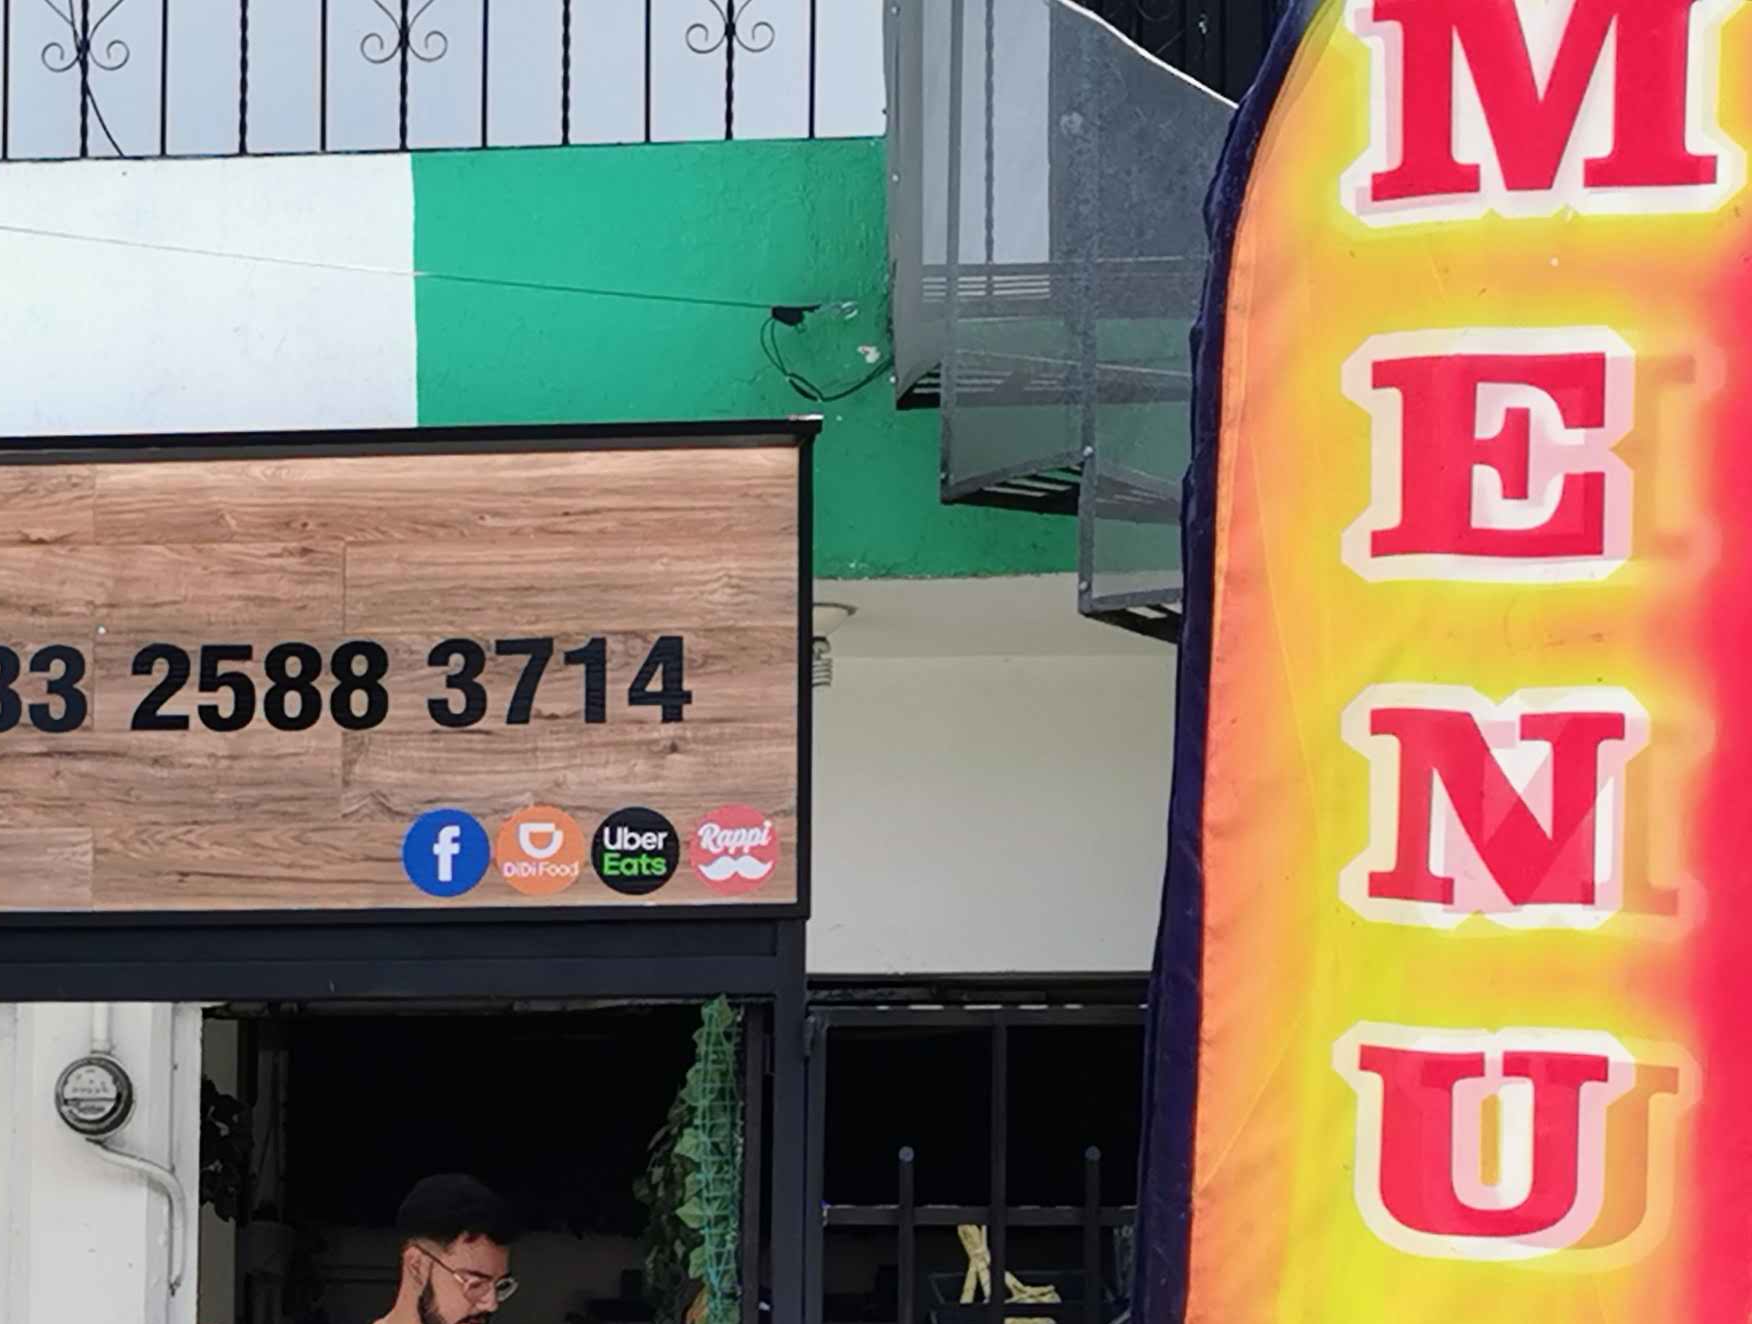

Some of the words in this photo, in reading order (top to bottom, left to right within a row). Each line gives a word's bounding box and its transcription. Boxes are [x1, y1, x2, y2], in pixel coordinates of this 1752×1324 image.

[130, 637, 389, 732] 2588
[426, 635, 693, 726] 3714
[602, 825, 669, 851] Uber
[697, 819, 773, 857] Rappi
[602, 852, 667, 876] Eats
